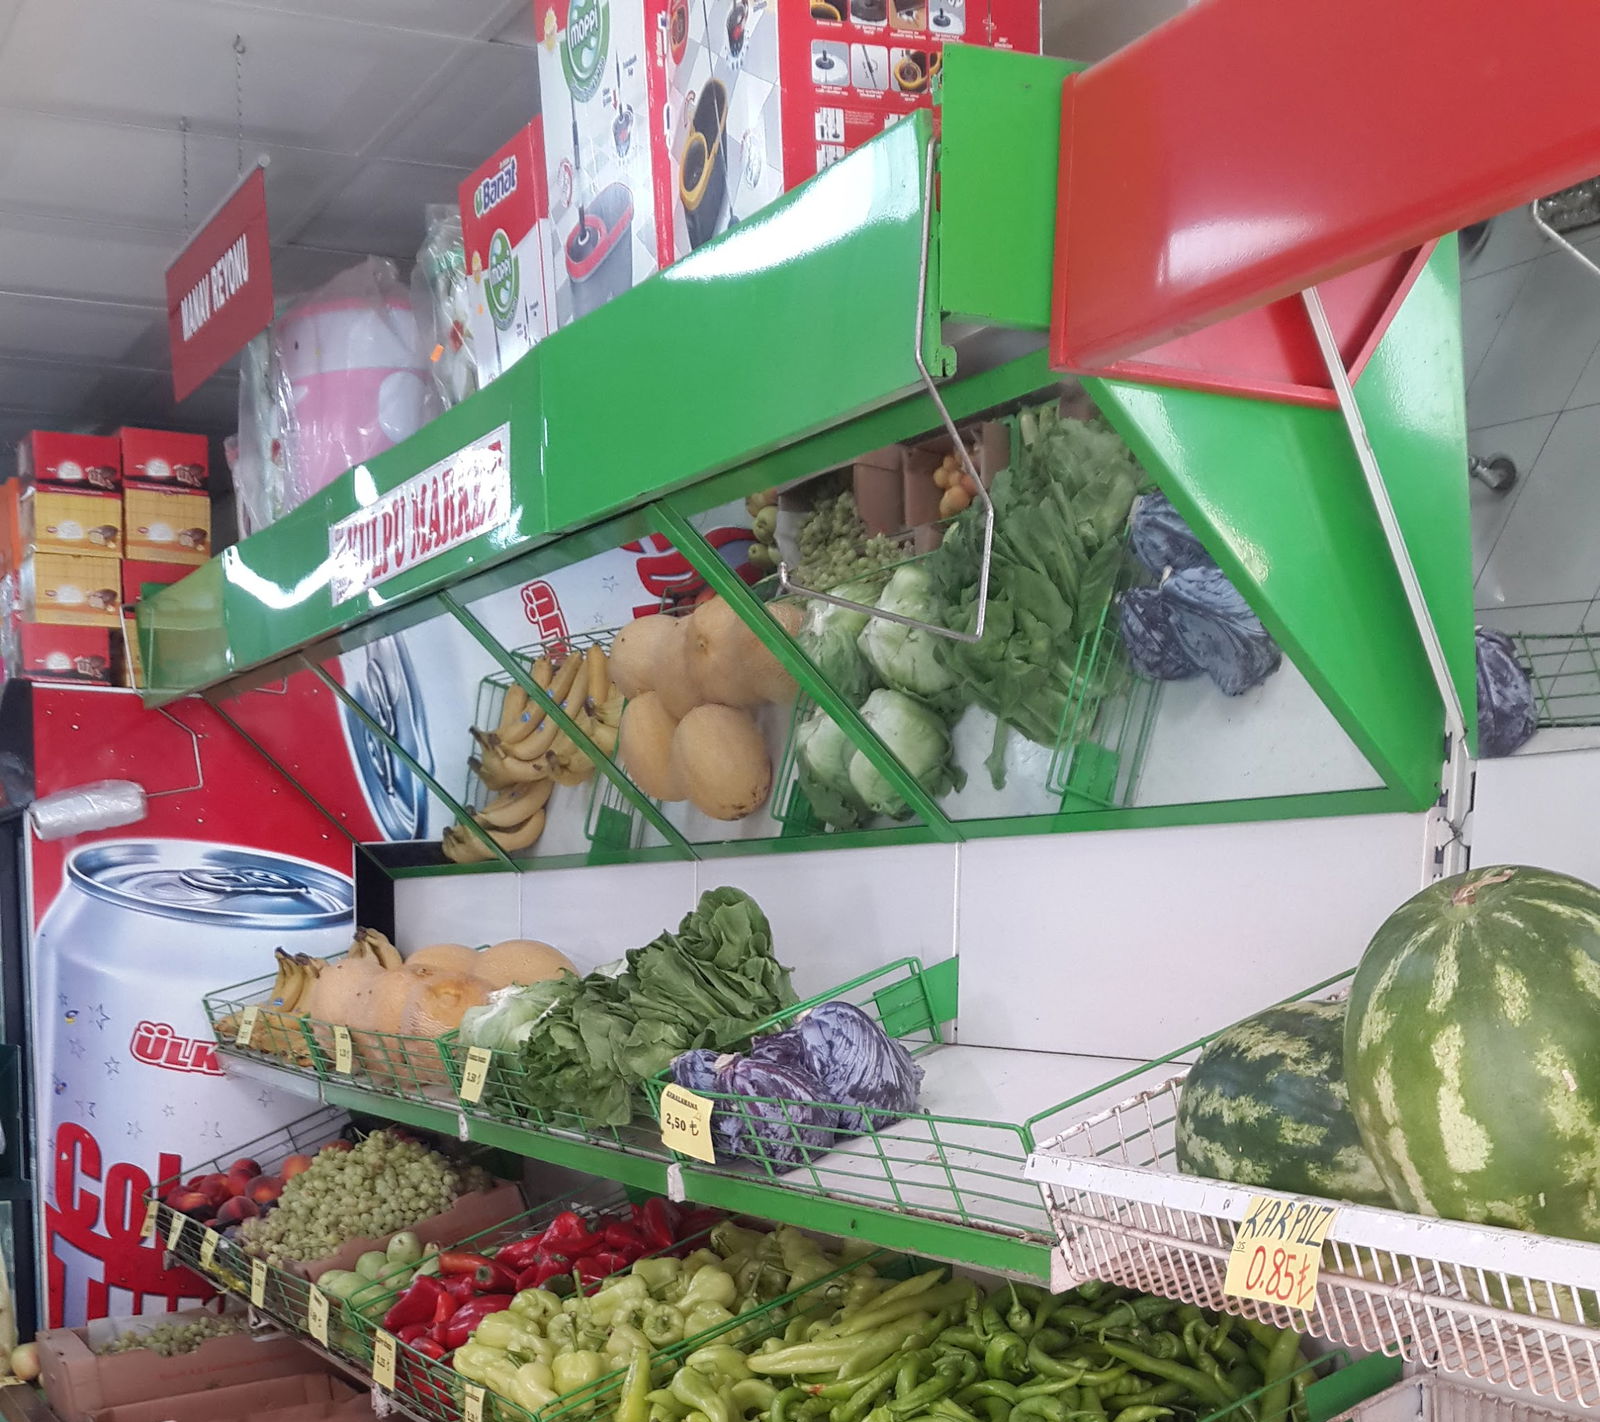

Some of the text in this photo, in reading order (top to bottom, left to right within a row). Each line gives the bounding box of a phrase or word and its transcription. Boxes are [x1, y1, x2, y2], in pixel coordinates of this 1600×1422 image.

[482, 160, 517, 211] Banat
[1242, 1197, 1335, 1248] KARPUZ
[1246, 1245, 1297, 1301] 0.85
